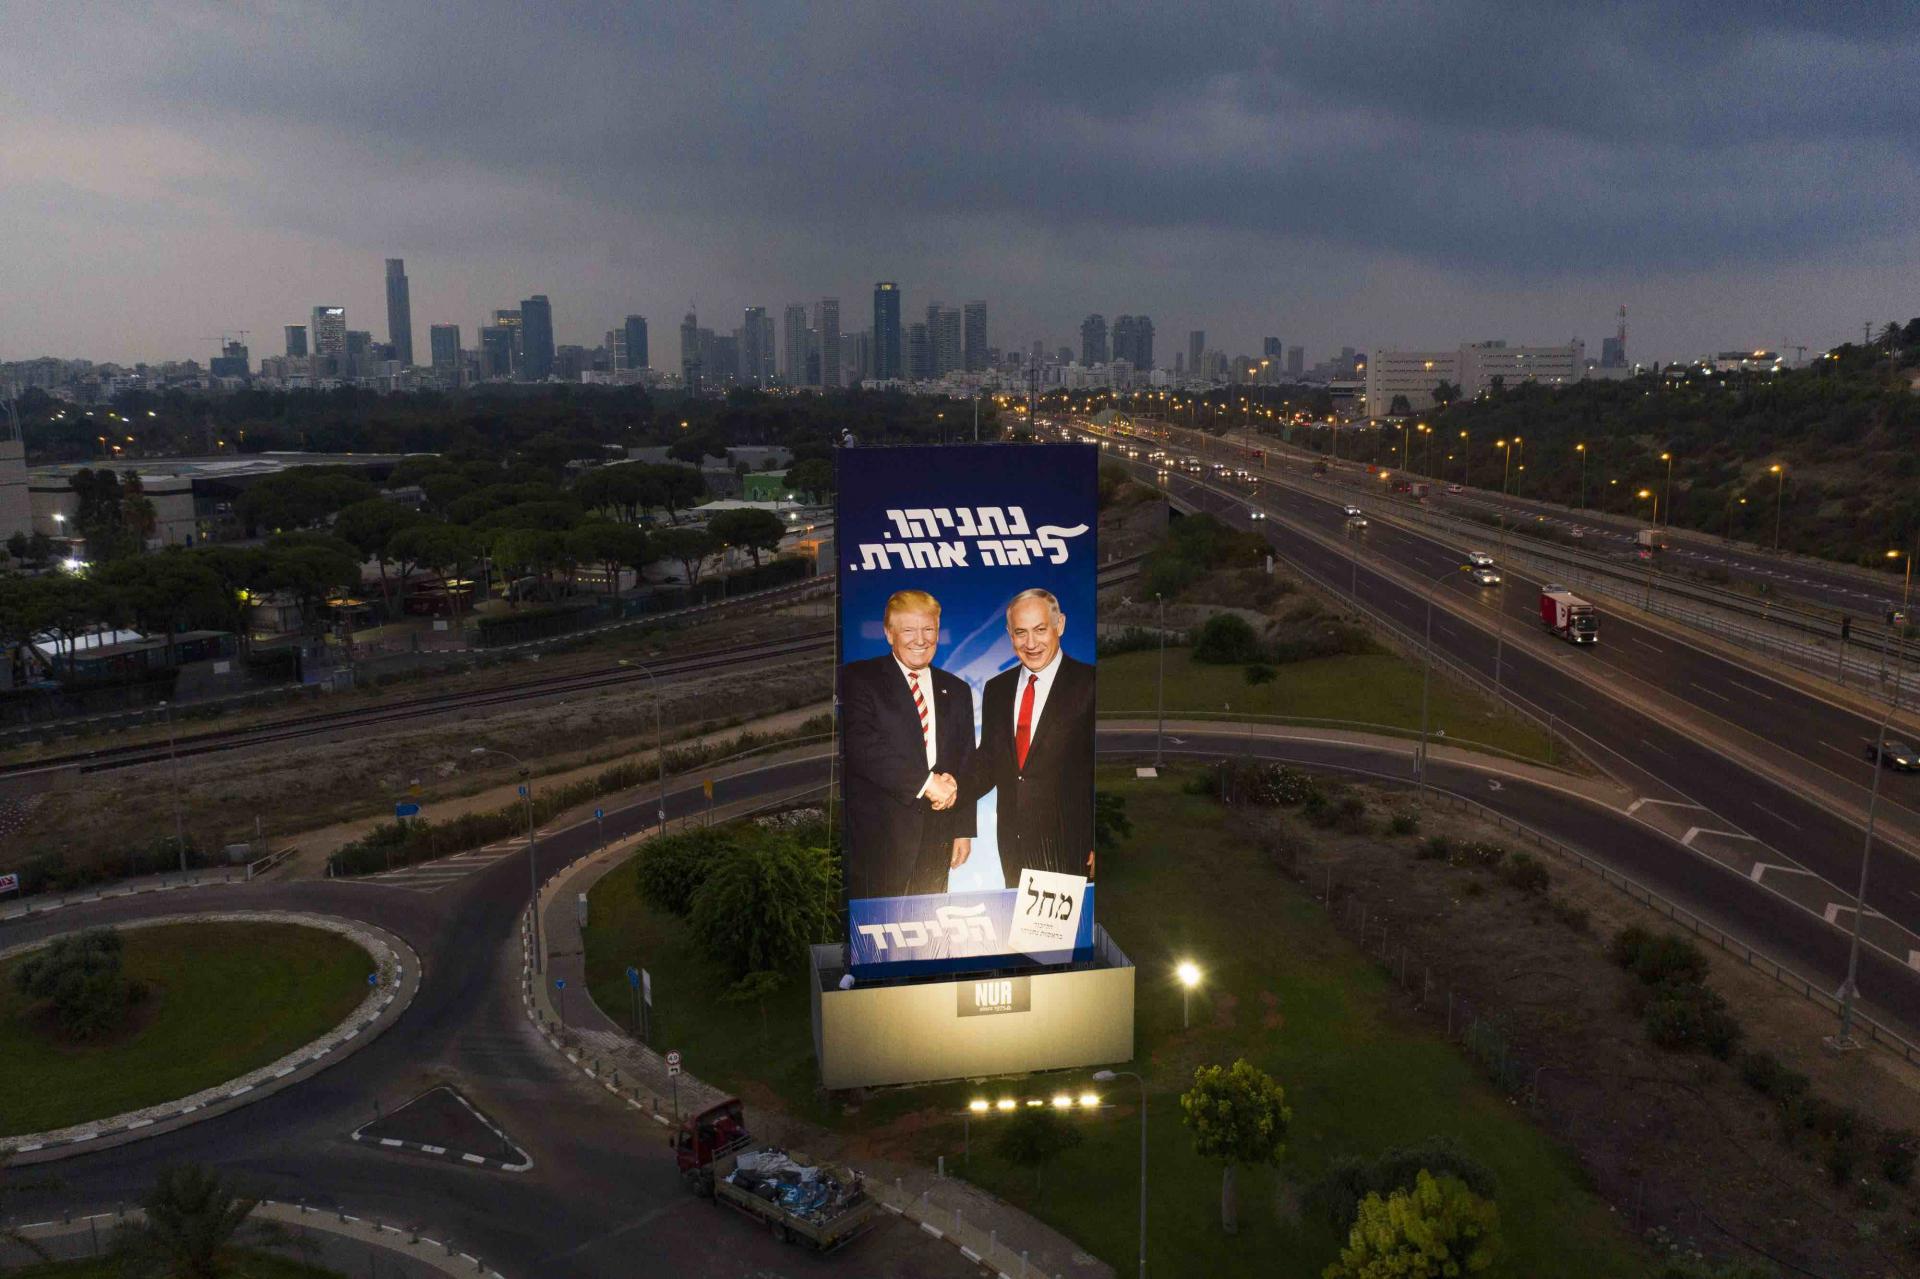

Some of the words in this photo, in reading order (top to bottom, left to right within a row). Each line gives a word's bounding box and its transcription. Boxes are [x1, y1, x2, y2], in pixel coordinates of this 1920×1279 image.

[883, 506, 1031, 538] נתניהו.
[850, 541, 969, 571] אחרת.
[976, 523, 1090, 566] ליגה
[1026, 877, 1073, 921] מחל
[859, 903, 997, 949] הליכוד
[975, 981, 1012, 1006] NUR
